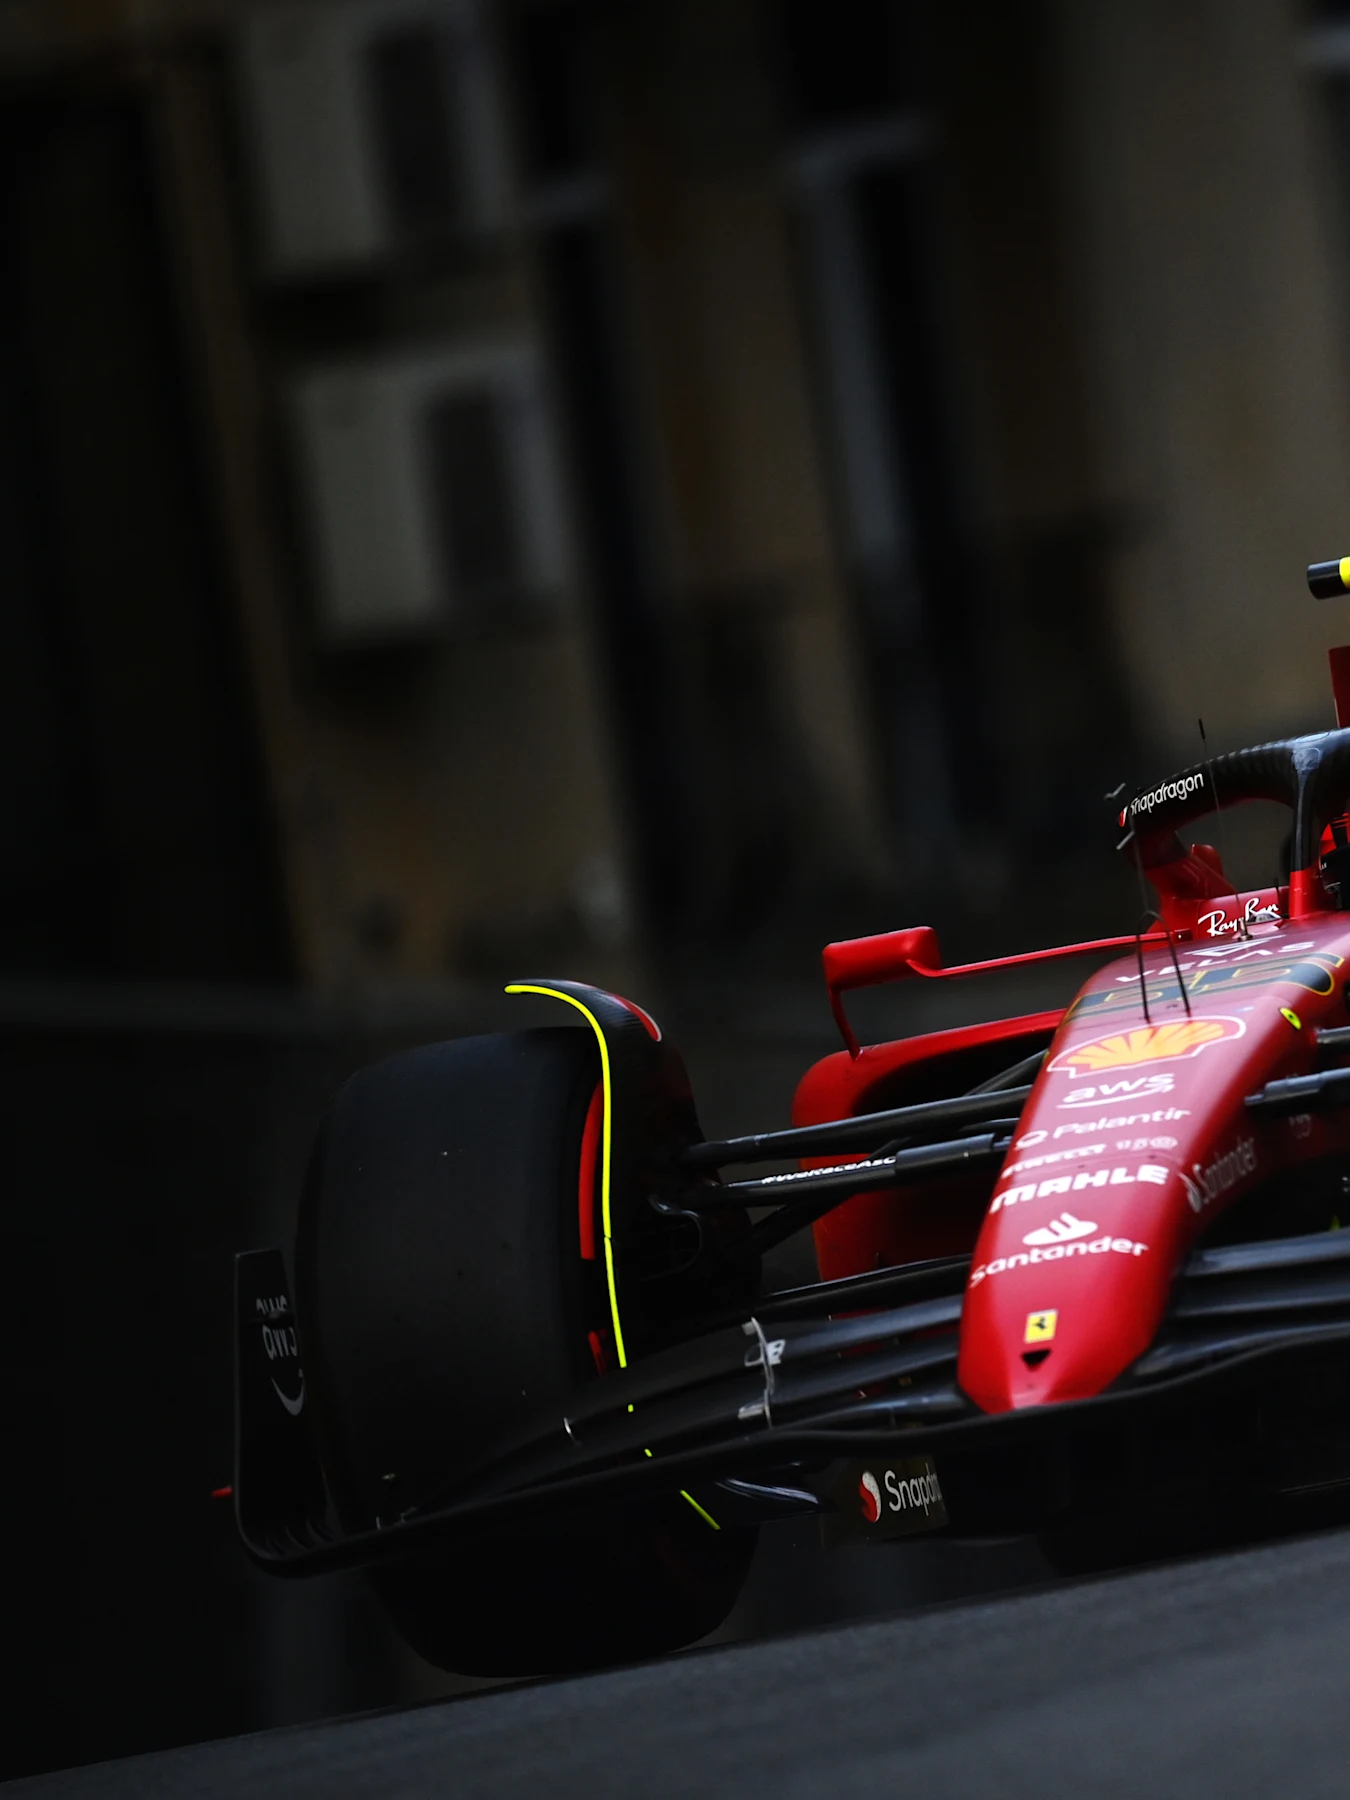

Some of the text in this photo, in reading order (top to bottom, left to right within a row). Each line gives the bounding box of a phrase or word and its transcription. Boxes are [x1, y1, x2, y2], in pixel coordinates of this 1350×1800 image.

[1115, 941, 1315, 983] VELAS
[1062, 1072, 1176, 1103] aws
[1052, 1106, 1192, 1140] Palantir
[989, 1164, 1170, 1215] MAHLE
[970, 1236, 1149, 1289] Santander
